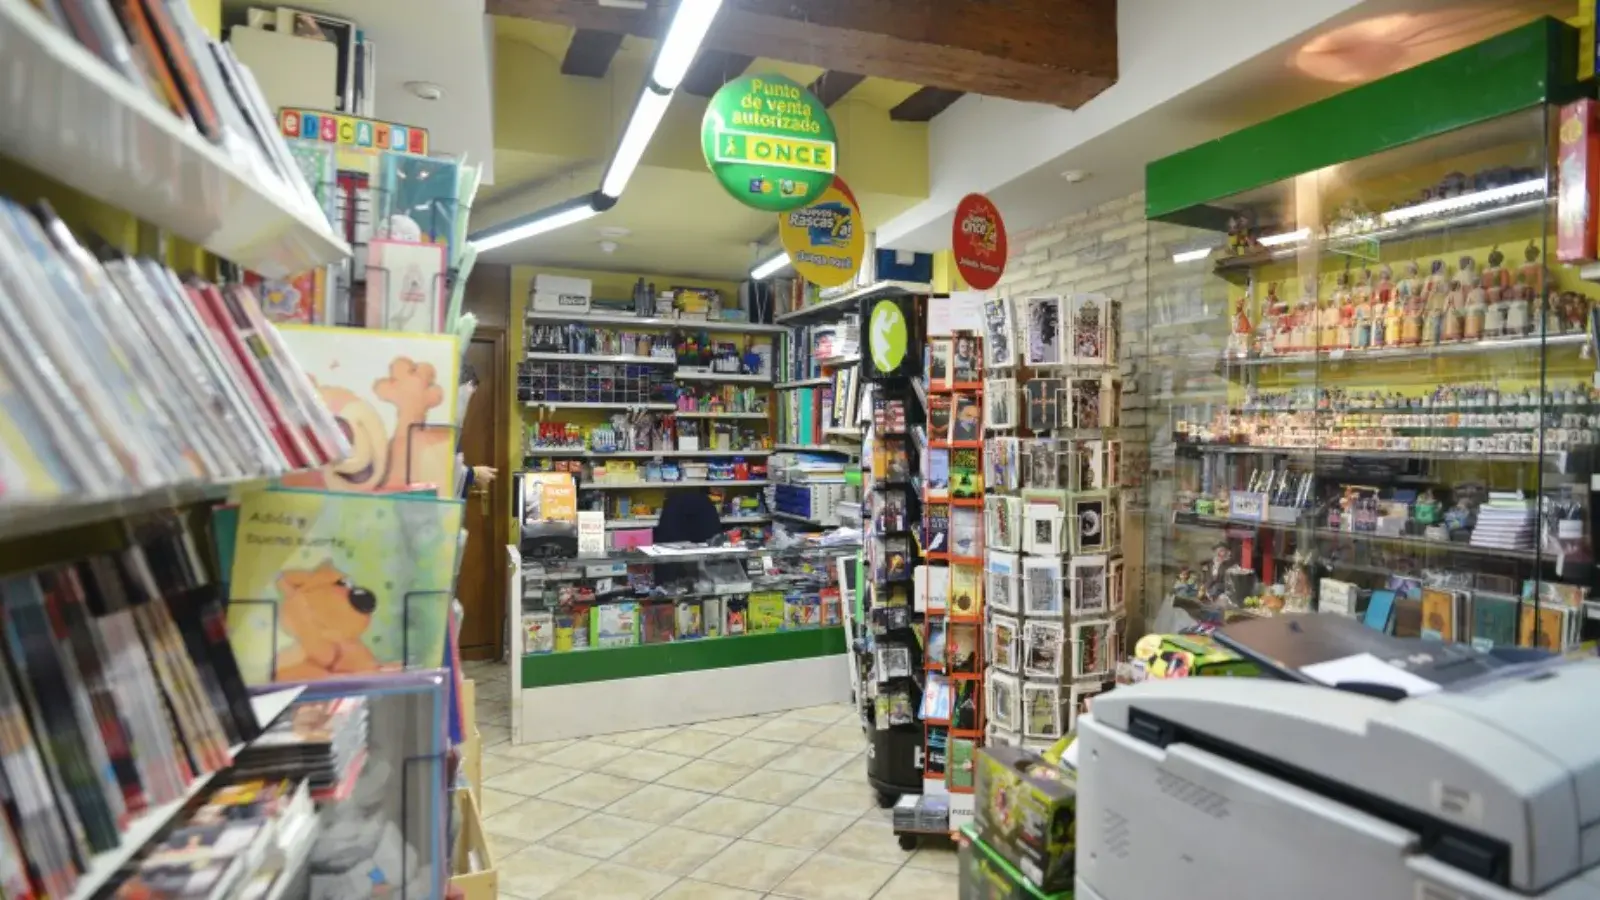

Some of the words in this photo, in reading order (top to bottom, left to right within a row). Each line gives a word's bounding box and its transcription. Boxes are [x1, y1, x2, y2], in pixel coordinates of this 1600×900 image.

[752, 79, 800, 98] Punto
[742, 94, 763, 109] de
[766, 99, 812, 116] venta
[732, 111, 820, 133] autorizado
[754, 142, 827, 165] ONCE
[790, 213, 834, 228] Rascas
